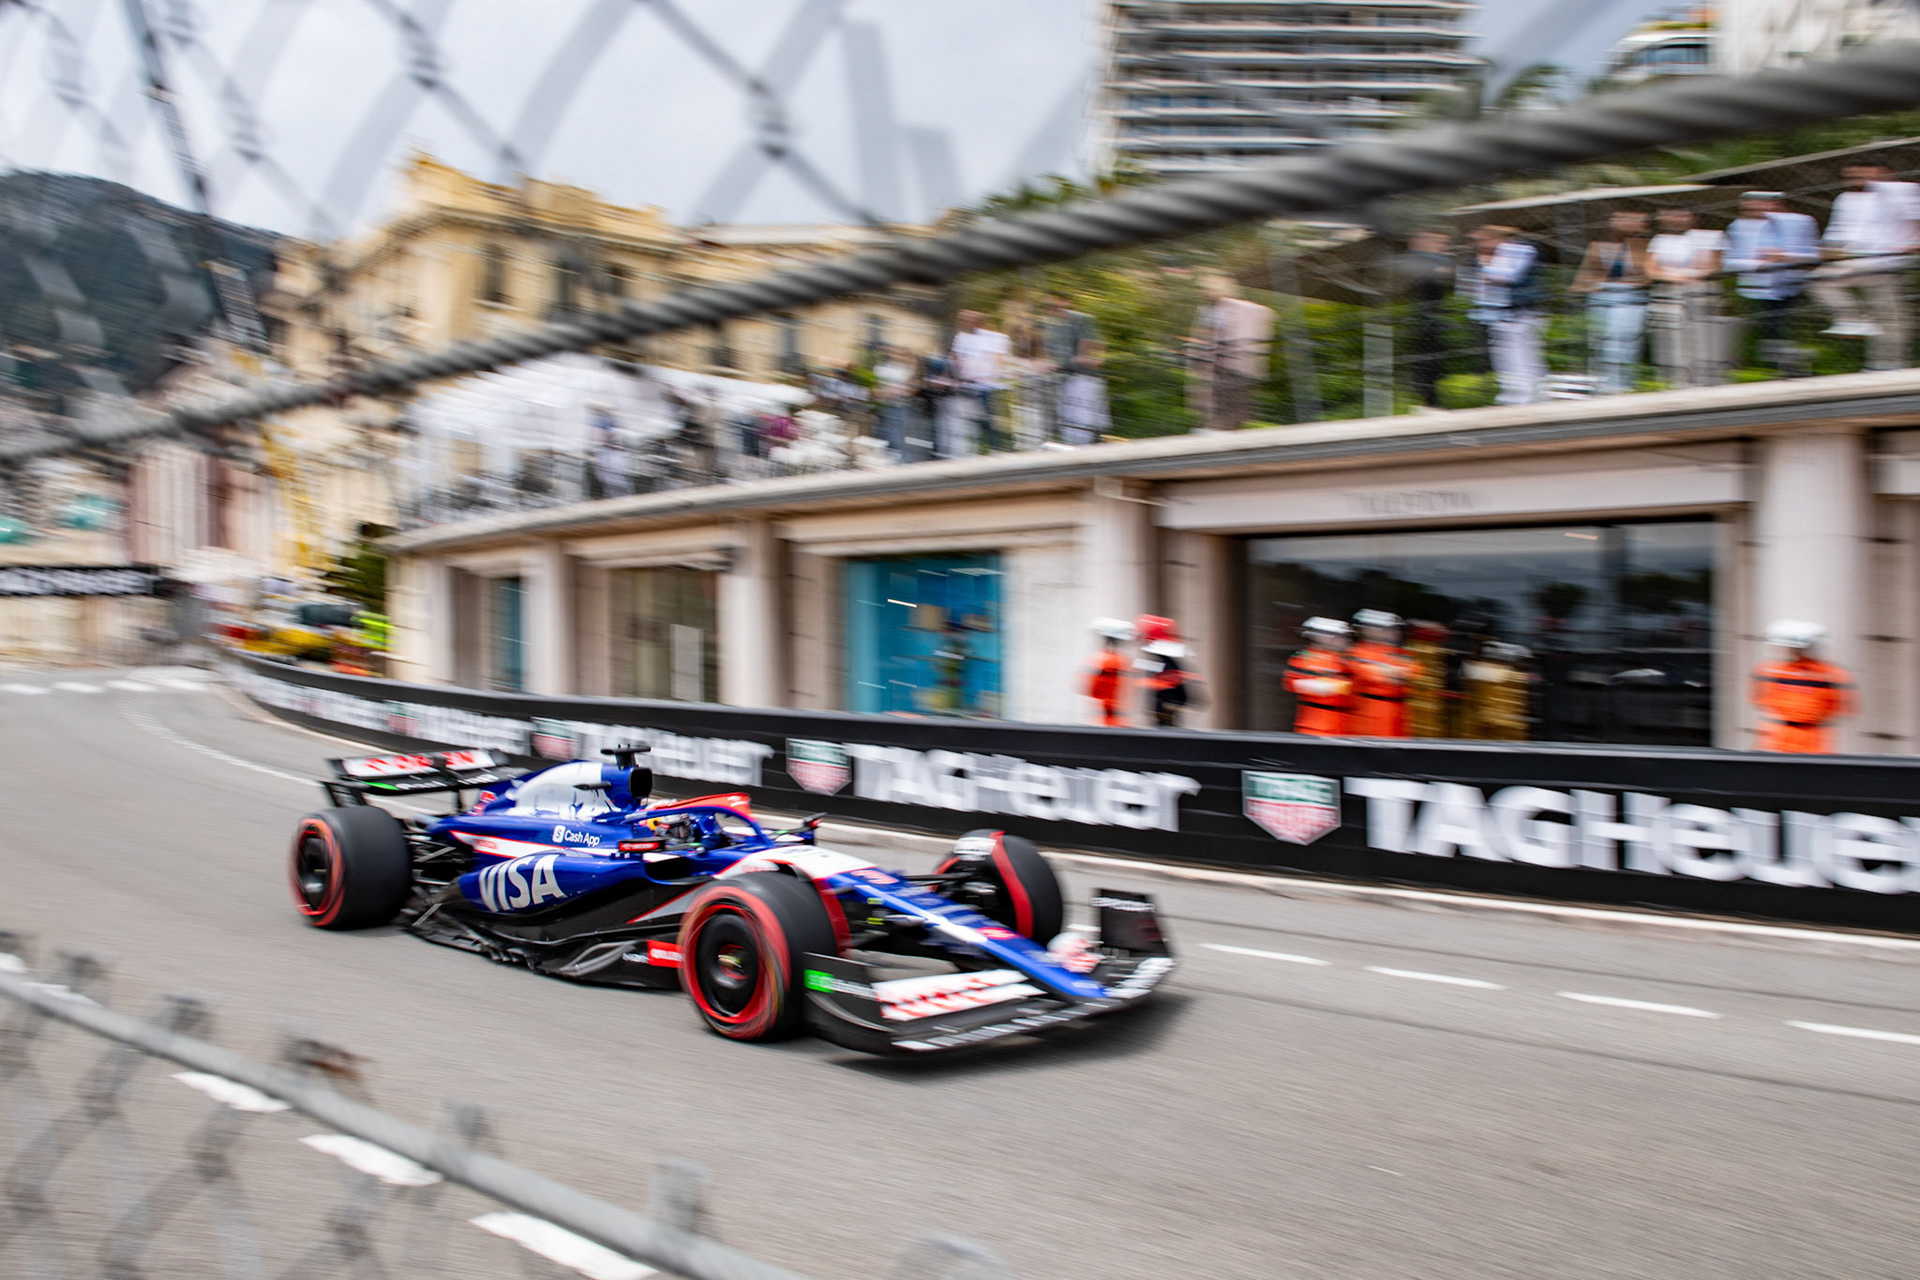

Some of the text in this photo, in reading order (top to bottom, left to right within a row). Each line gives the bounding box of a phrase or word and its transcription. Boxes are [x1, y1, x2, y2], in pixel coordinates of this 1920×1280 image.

[564, 829, 600, 847] Cash App
[478, 853, 568, 913] VISA
